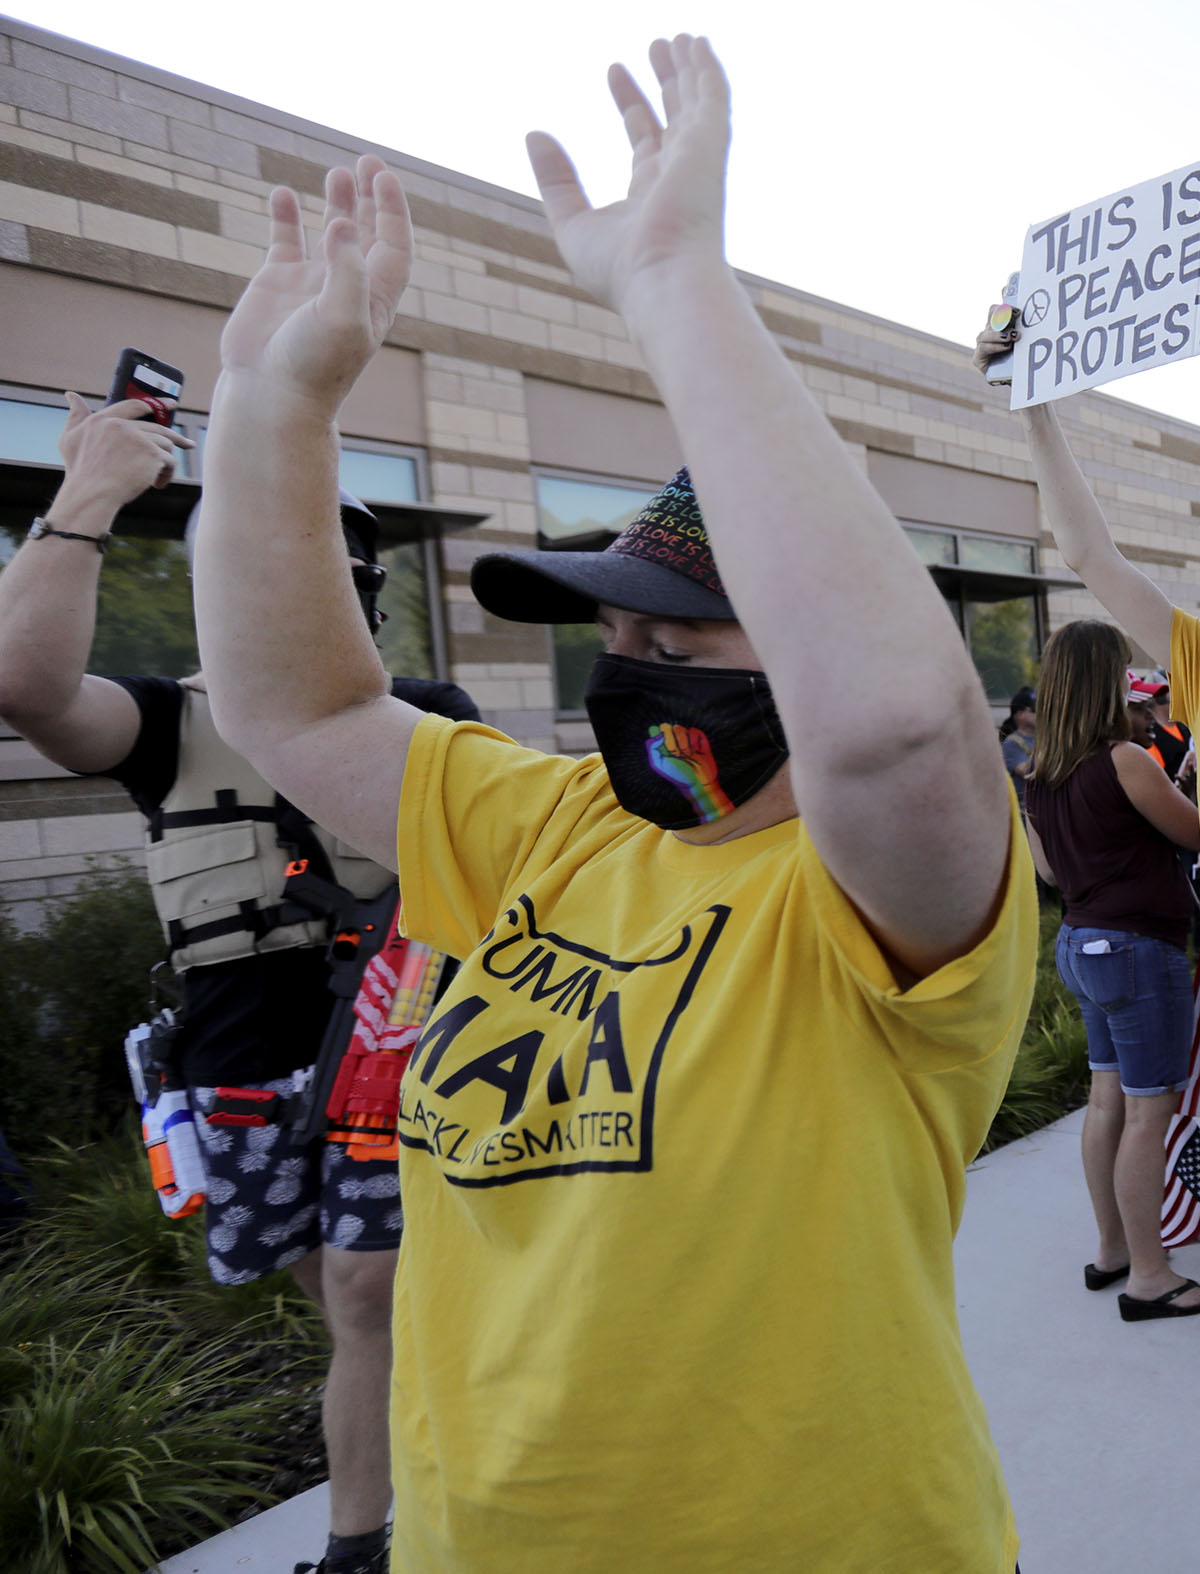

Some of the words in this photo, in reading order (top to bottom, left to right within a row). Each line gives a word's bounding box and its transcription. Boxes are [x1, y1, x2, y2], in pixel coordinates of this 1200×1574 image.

[1032, 195, 1137, 276] THIS
[661, 515, 681, 527] IS
[643, 526, 683, 547] LOVE
[646, 543, 688, 567] LOVE
